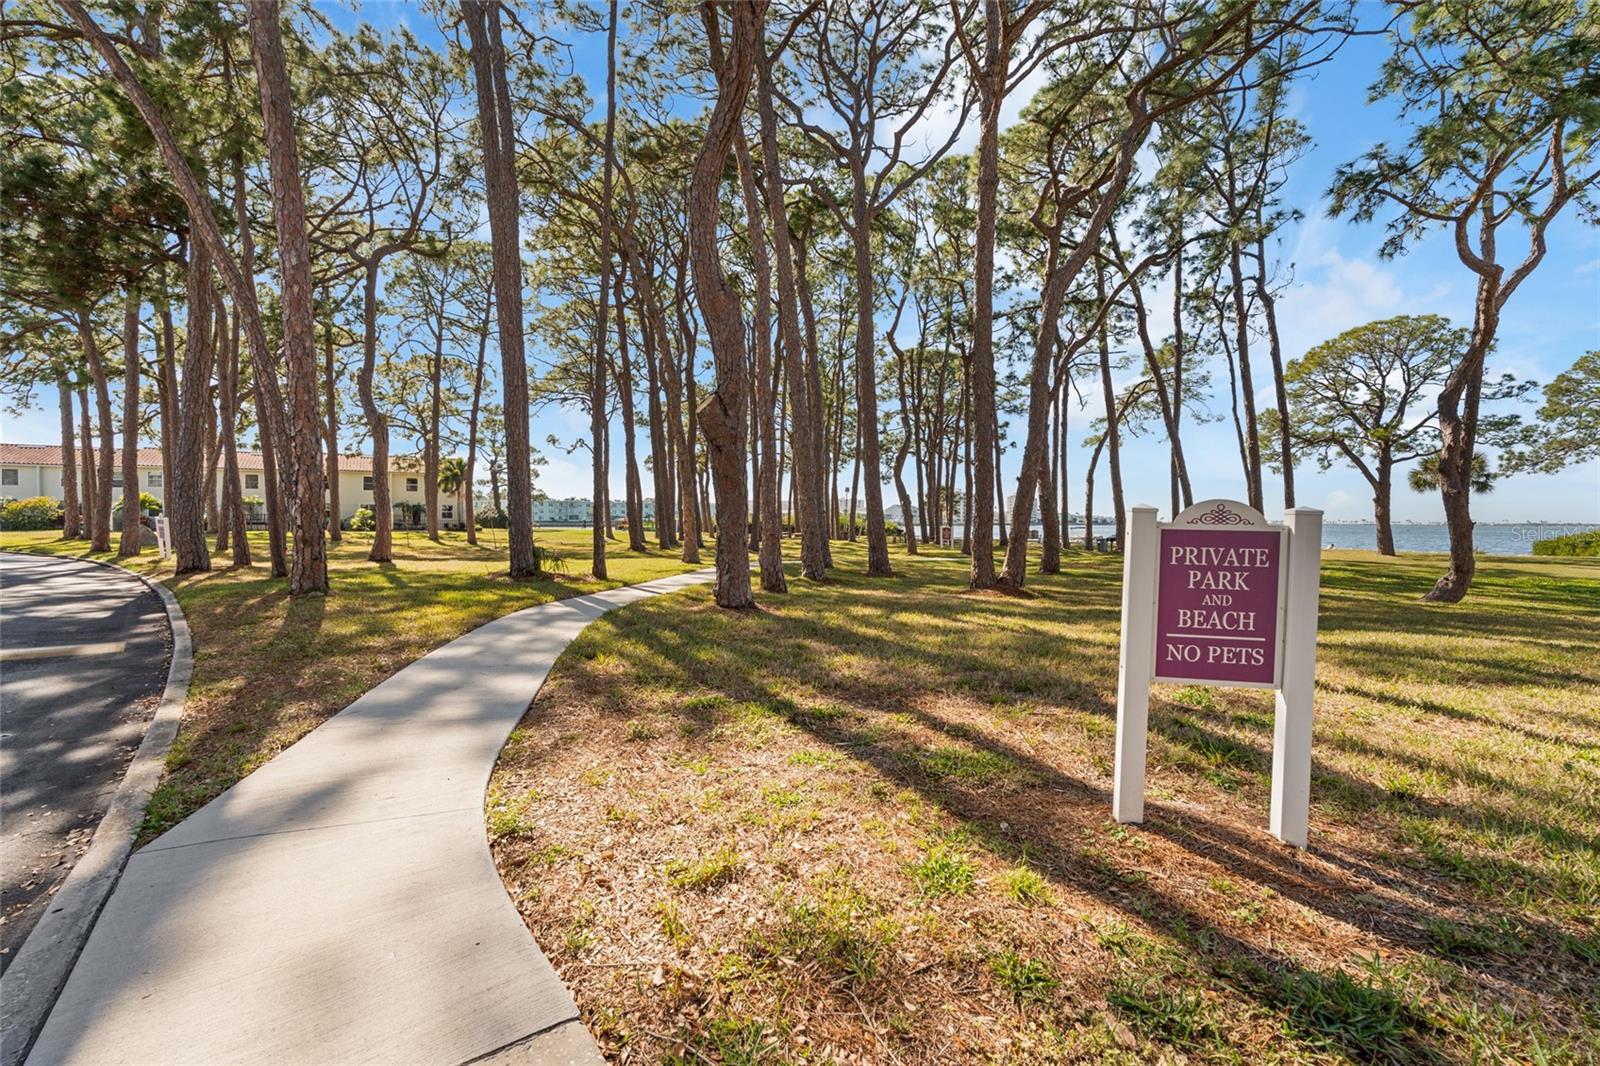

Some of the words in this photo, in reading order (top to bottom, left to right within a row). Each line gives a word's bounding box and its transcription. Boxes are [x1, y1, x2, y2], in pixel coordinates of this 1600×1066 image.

[1169, 546, 1270, 568] PRIVATE
[1187, 570, 1250, 591] PARK
[1201, 594, 1233, 606] AND
[1177, 609, 1256, 631] BEACH
[1165, 643, 1201, 663] NO
[1207, 645, 1265, 666] PETS
